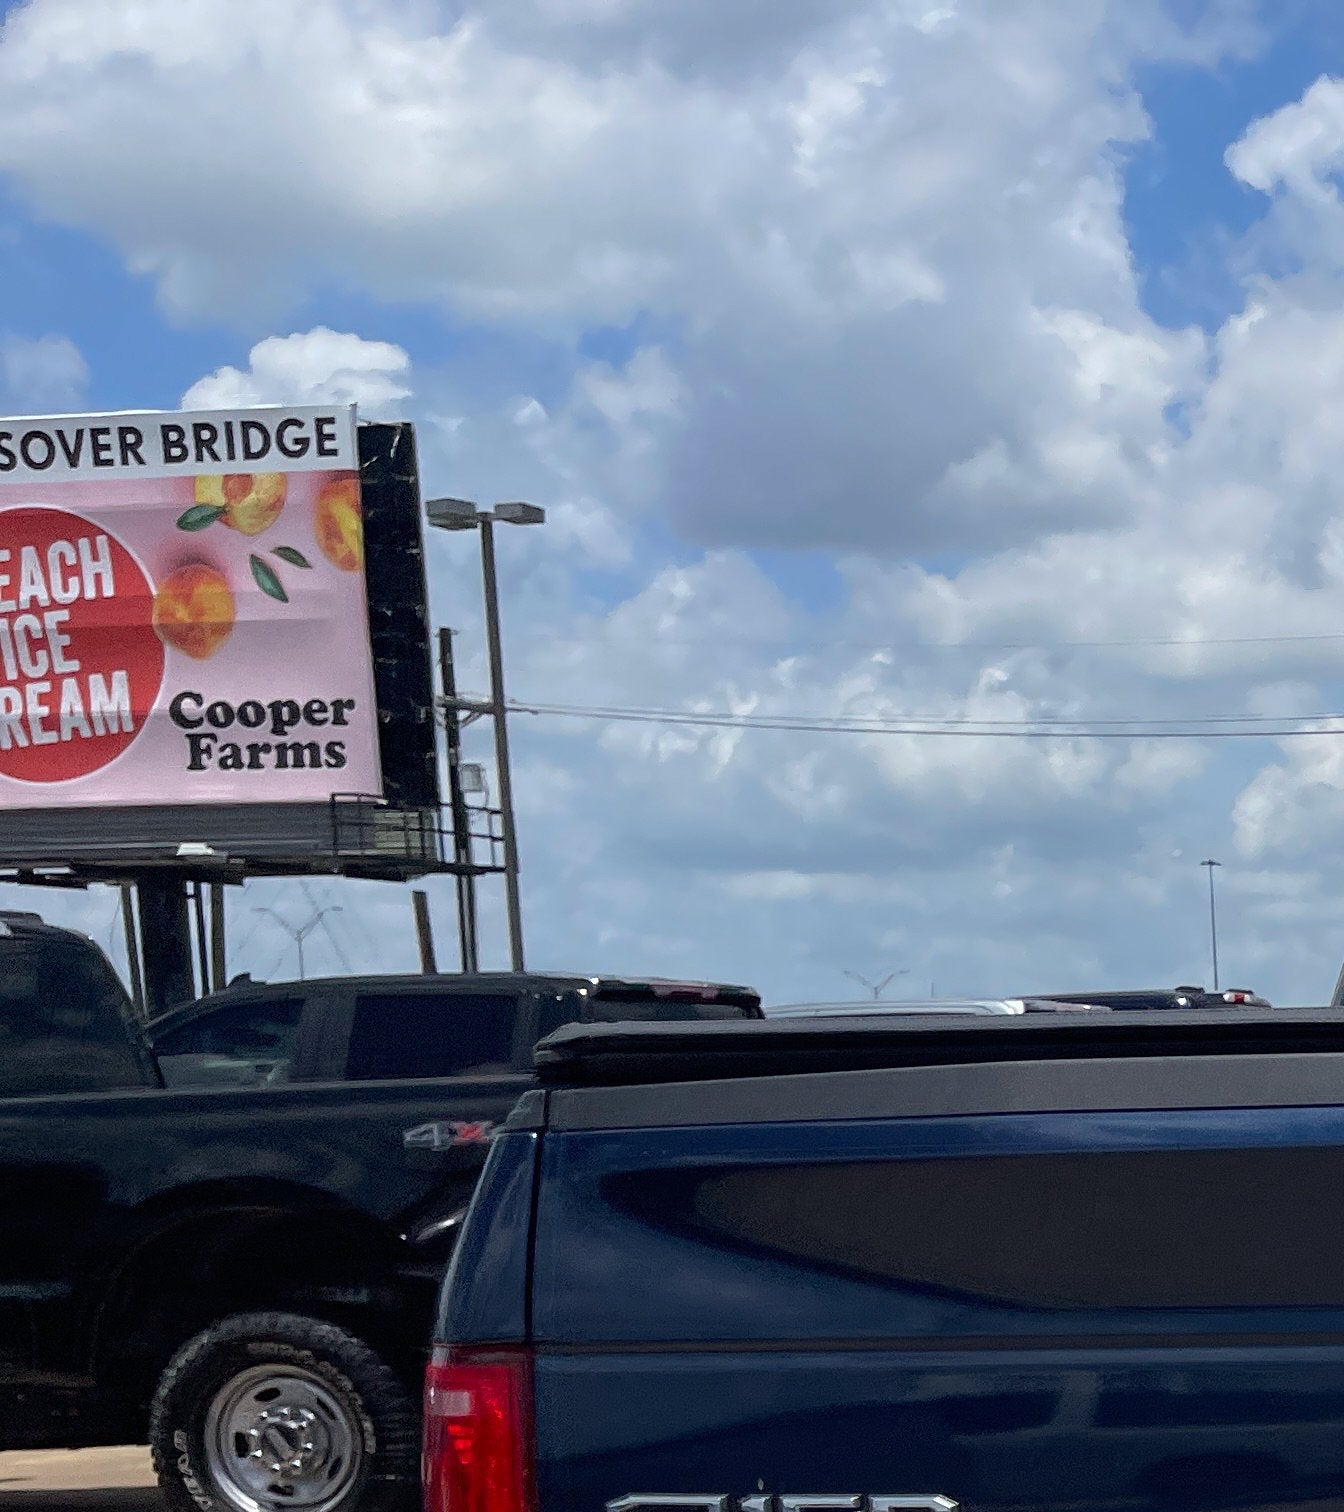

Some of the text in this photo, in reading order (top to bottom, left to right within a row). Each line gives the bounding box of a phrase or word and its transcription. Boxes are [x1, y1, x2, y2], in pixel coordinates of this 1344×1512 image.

[161, 416, 339, 465] BRIDGE
[0, 609, 80, 680] ICE
[169, 691, 355, 736] Cooper
[185, 733, 347, 771] Farms
